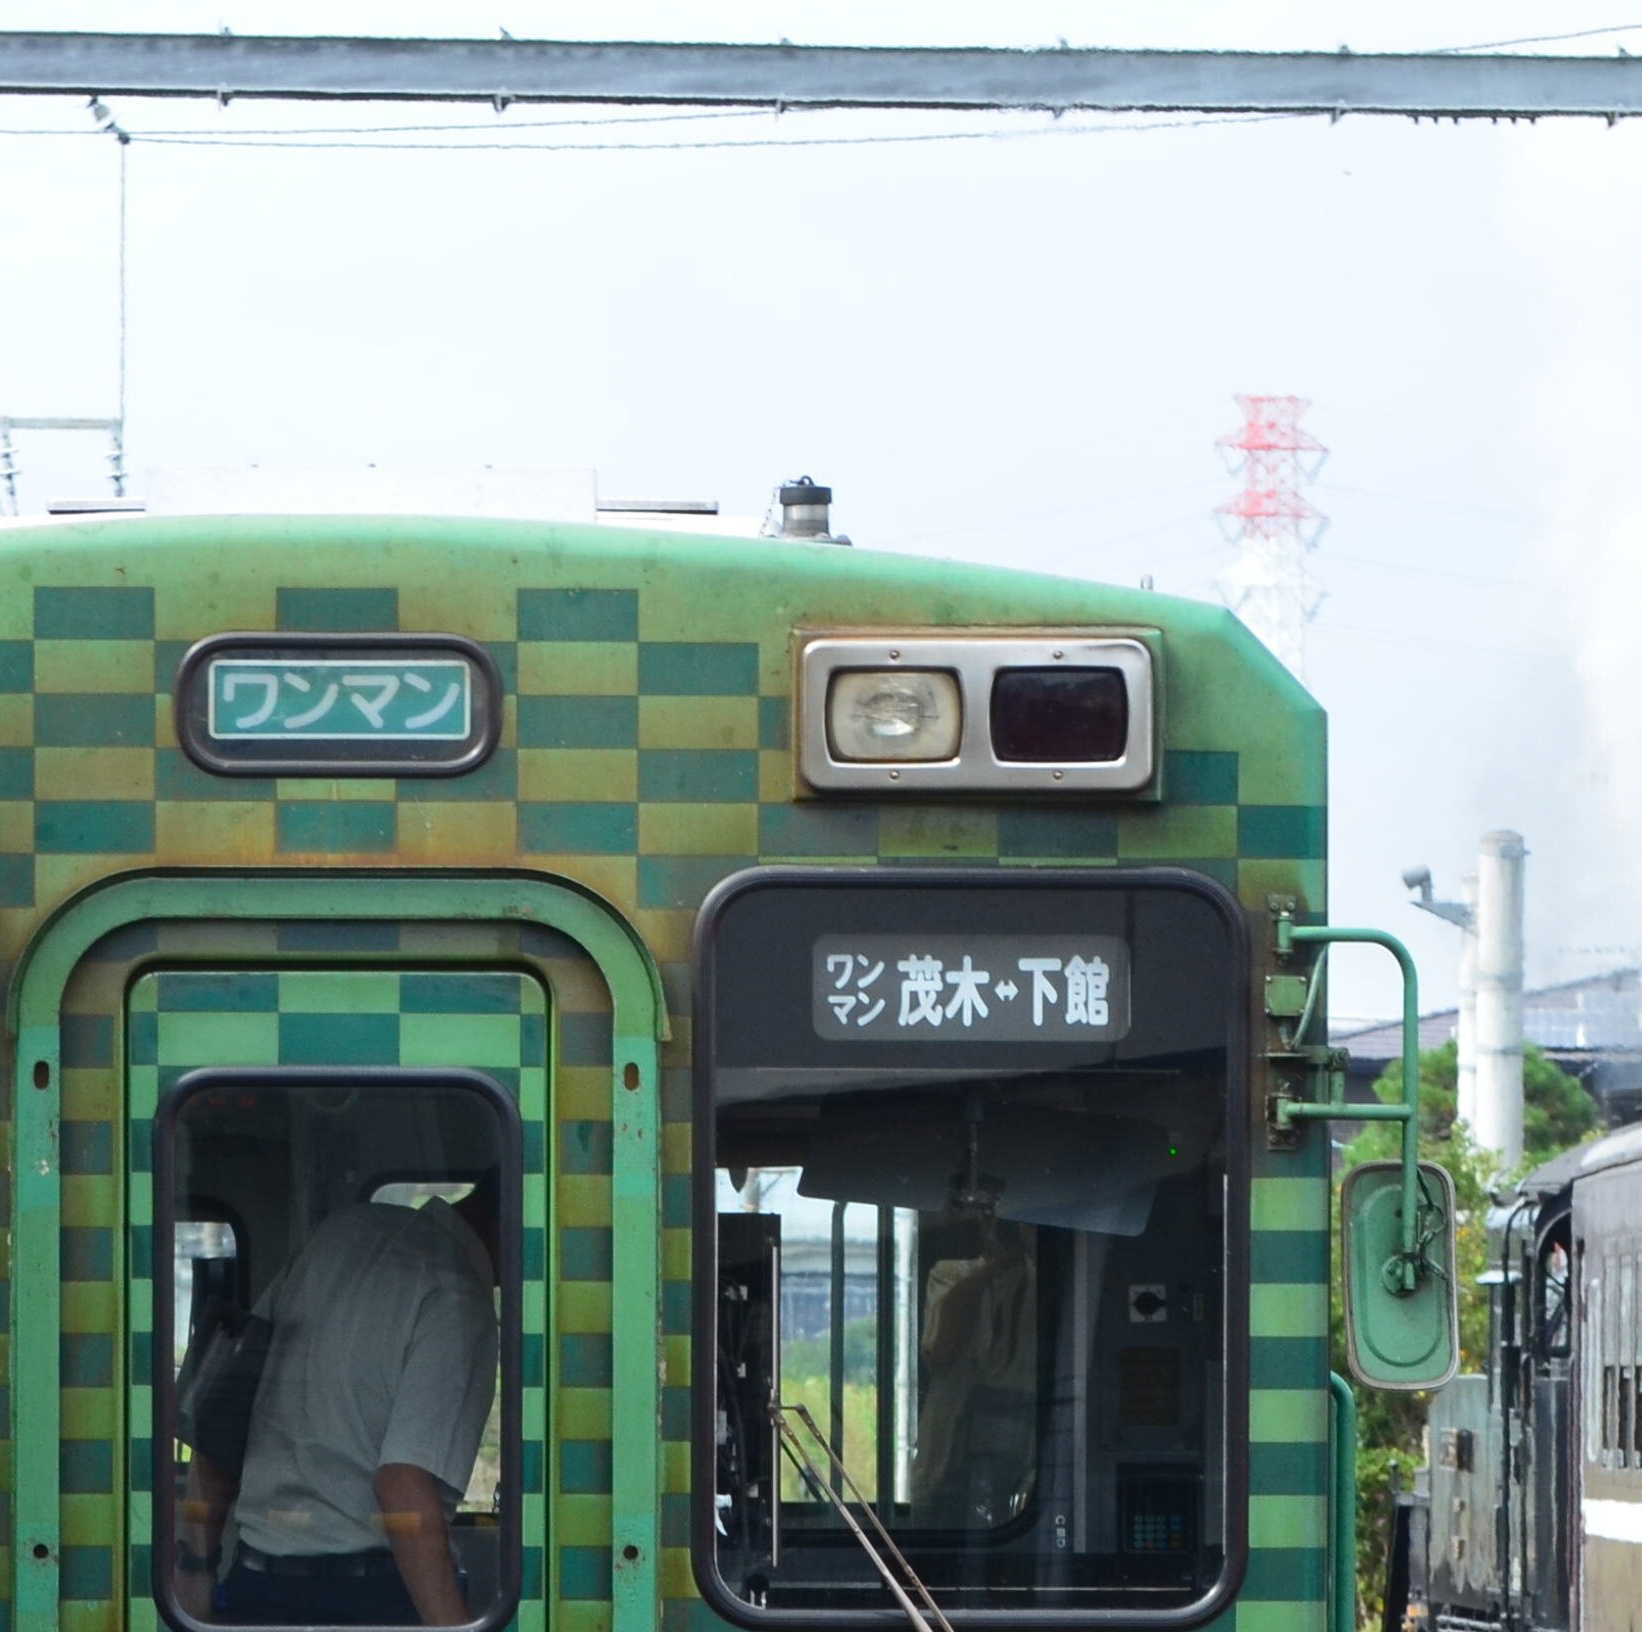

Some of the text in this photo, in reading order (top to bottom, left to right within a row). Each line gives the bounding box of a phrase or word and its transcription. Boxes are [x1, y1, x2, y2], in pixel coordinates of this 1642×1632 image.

[222, 672, 461, 729] ワンマン
[826, 954, 885, 989] ワン
[897, 953, 1110, 1027] 茂木 下館
[827, 991, 886, 1027] マン
